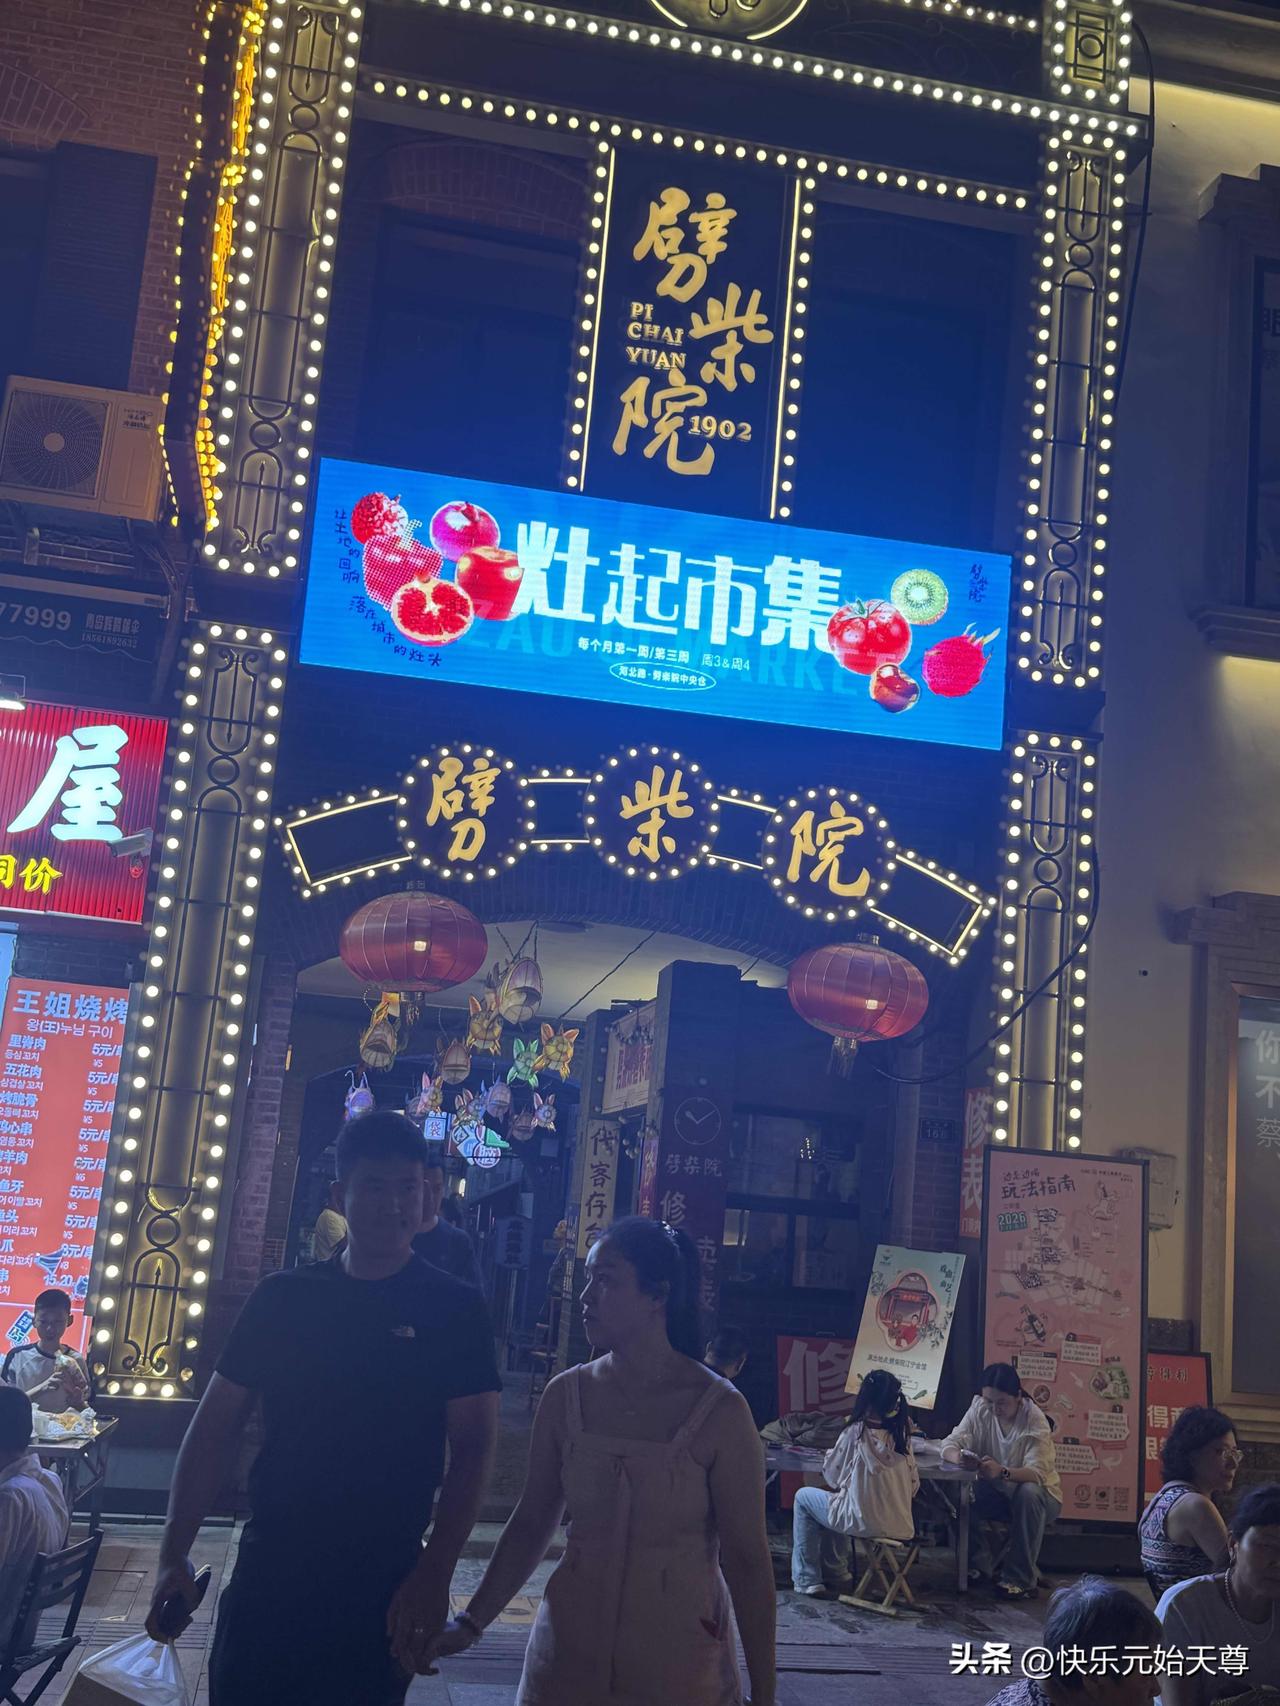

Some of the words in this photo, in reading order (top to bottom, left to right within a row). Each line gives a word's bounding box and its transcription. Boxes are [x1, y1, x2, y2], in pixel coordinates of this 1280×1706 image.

[631, 302, 653, 321] PI
[627, 322, 683, 346] CHAI
[626, 346, 687, 370] YUAN
[688, 415, 752, 441] 1902
[511, 519, 842, 655] 灶起市集
[7, 724, 129, 841] 屋
[88, 1025, 113, 1039] 구이
[4, 1062, 43, 1079] 五花肉
[1001, 1174, 1076, 1200] 玩法指南
